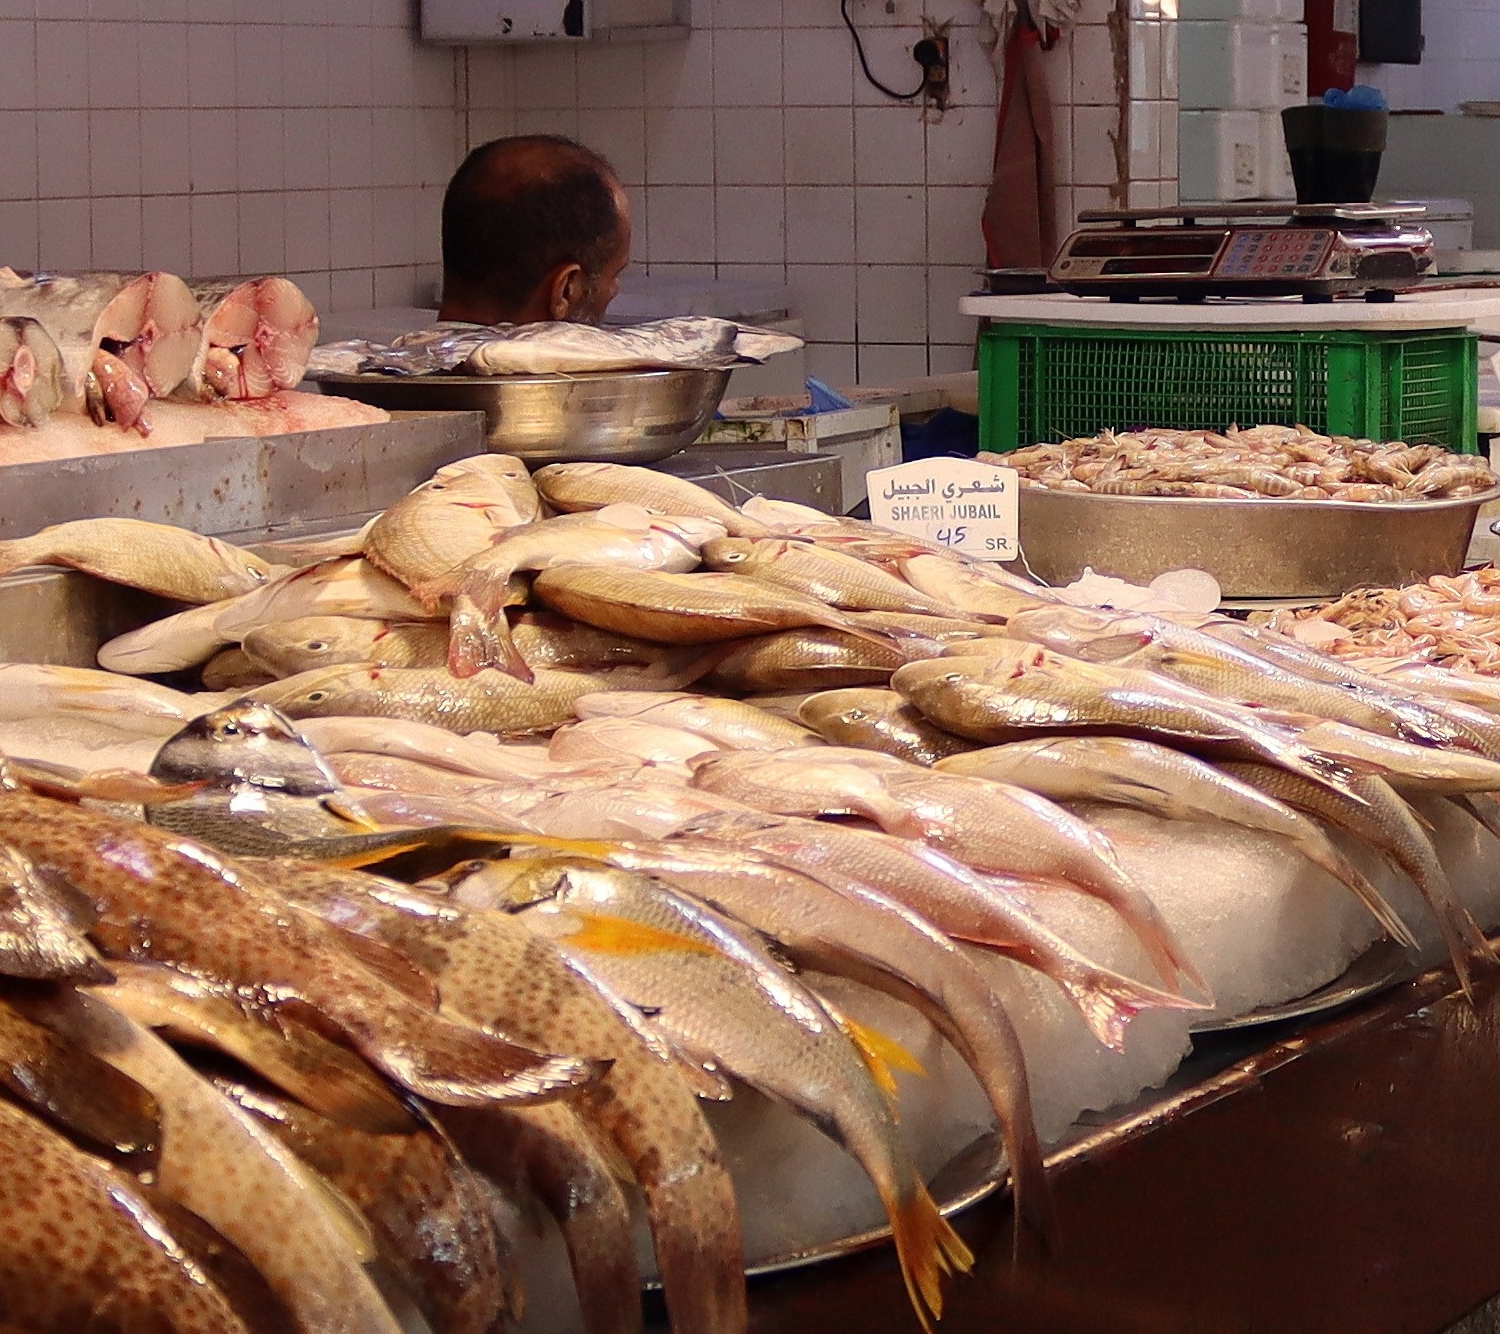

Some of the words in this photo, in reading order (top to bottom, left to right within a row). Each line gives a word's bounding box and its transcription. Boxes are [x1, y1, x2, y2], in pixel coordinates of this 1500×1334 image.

[883, 478, 935, 500] الجبيل
[941, 474, 1005, 503] شعري
[892, 505, 944, 521] SHAERI
[950, 504, 1001, 520] JUBAIL
[937, 525, 967, 546] 45
